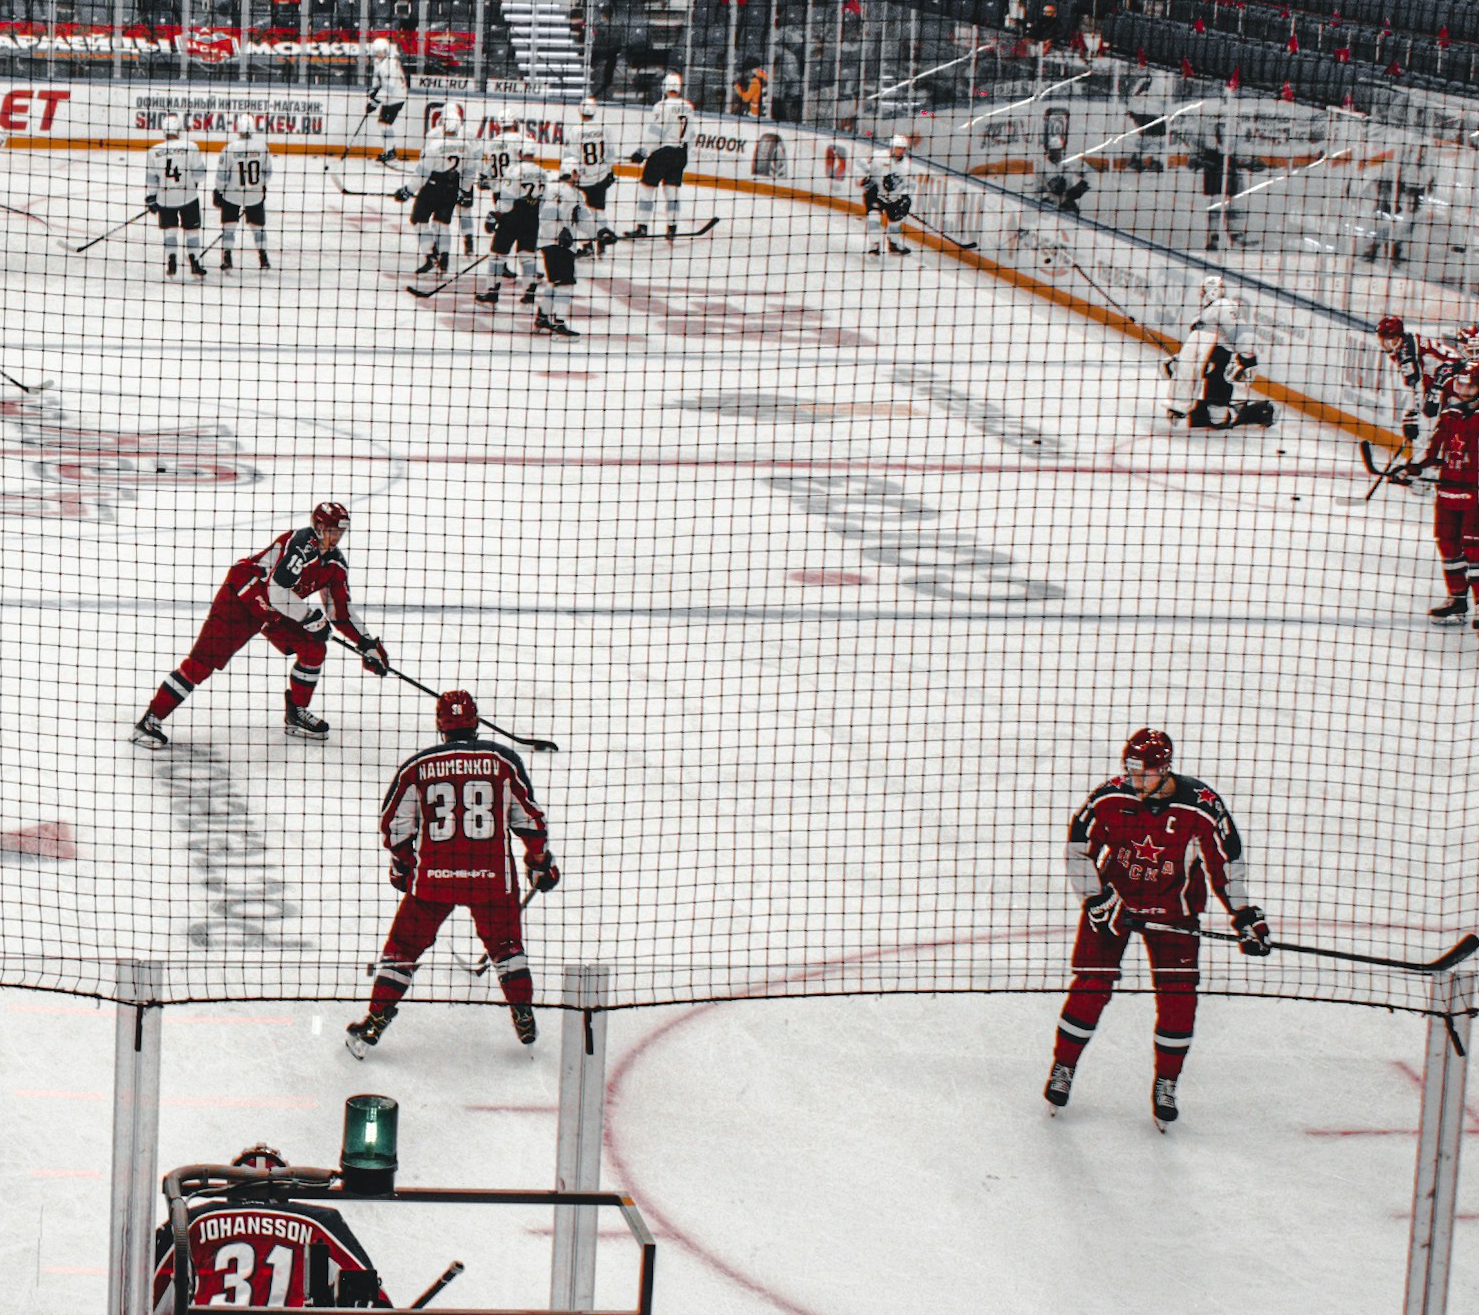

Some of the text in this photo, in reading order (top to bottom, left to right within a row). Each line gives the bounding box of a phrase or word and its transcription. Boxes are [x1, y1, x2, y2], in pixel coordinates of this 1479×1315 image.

[418, 77, 469, 91] KHL.RU
[495, 81, 542, 95] KHL.RU
[136, 93, 324, 113] ОФИЦИАЛЬНЫЙ ИНТЕРНЕТ-МАГАЗИН:
[583, 141, 605, 166] 81
[165, 159, 183, 183] 4
[237, 159, 261, 186] 10
[418, 757, 501, 778] NAUMENKOV
[425, 780, 496, 841] 38
[1166, 815, 1177, 834] C
[426, 867, 496, 880] РОСНЕФТЬ
[1116, 846, 1175, 883] ЦСКА
[197, 1214, 314, 1246] JOHANSSON
[207, 1240, 296, 1308] 31
